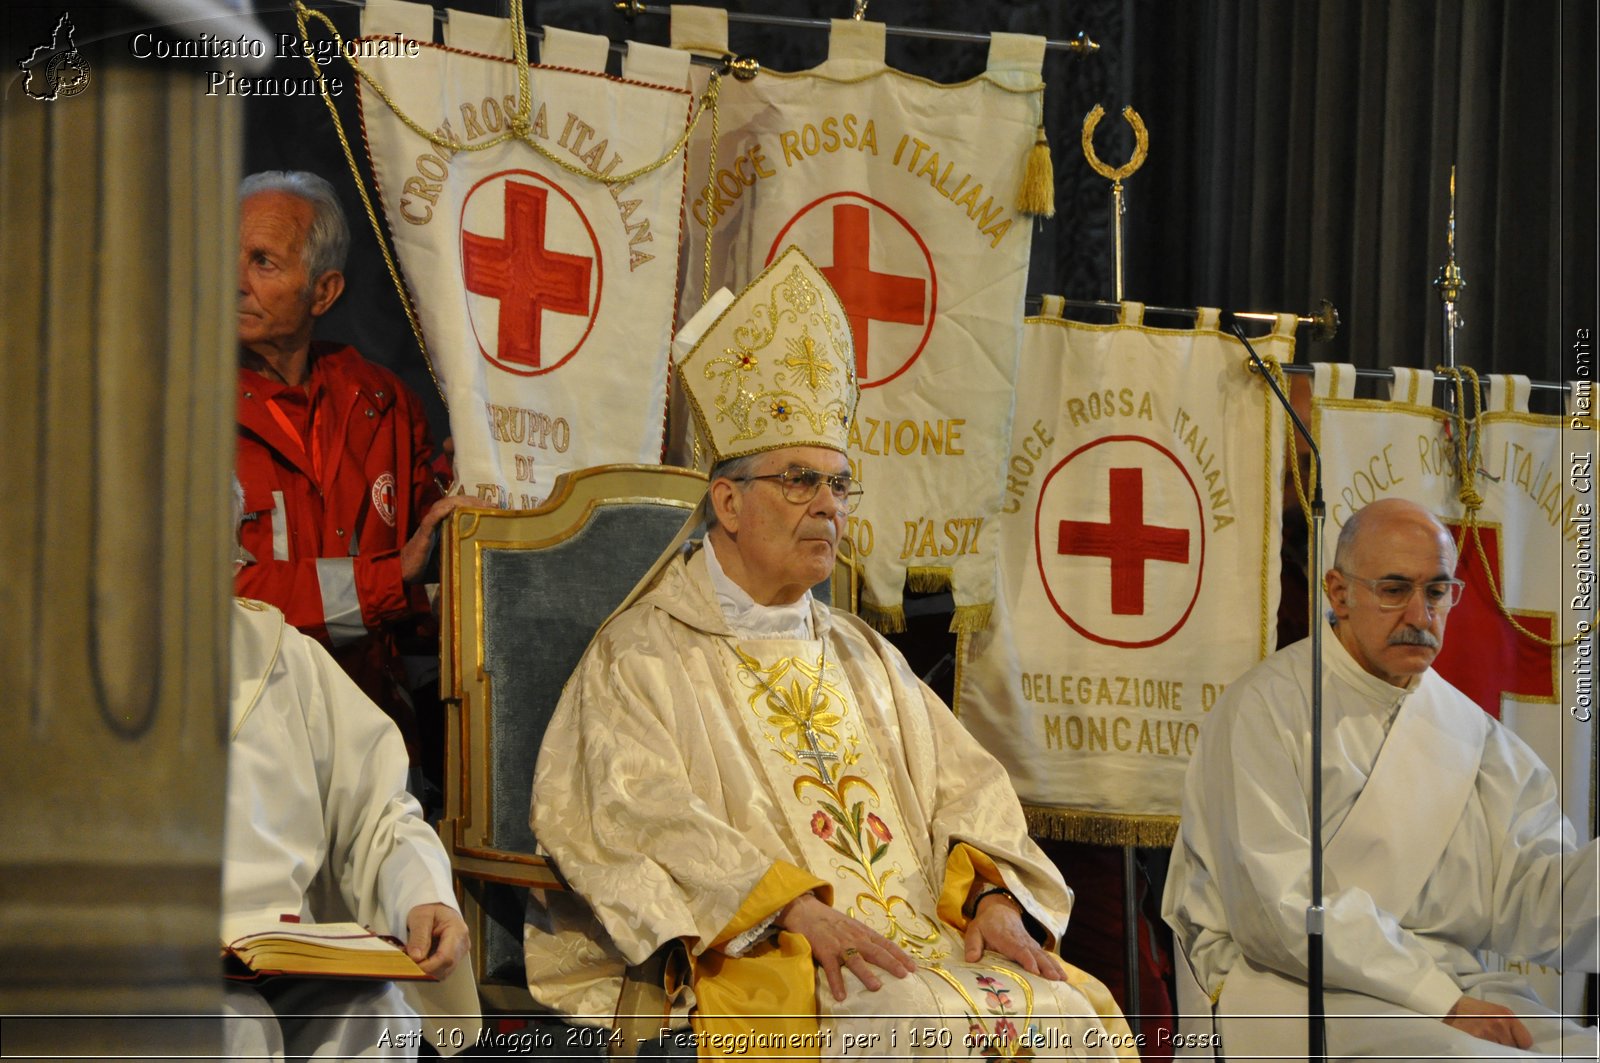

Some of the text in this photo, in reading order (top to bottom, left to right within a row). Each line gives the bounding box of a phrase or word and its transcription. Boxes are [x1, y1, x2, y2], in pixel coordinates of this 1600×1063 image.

[459, 94, 549, 141] ROSA
[557, 112, 656, 272] ITALIANA
[692, 113, 1013, 249] CROCE ROSSA ITALIANA
[486, 402, 570, 454] RUPPO
[515, 453, 537, 484] DI
[1001, 387, 1236, 533] CROCE ROSSA ITALIANA
[900, 516, 985, 560] D'ASTI
[1021, 672, 1184, 711] DELEGAZIONE
[1043, 713, 1200, 757] MONCALVO
